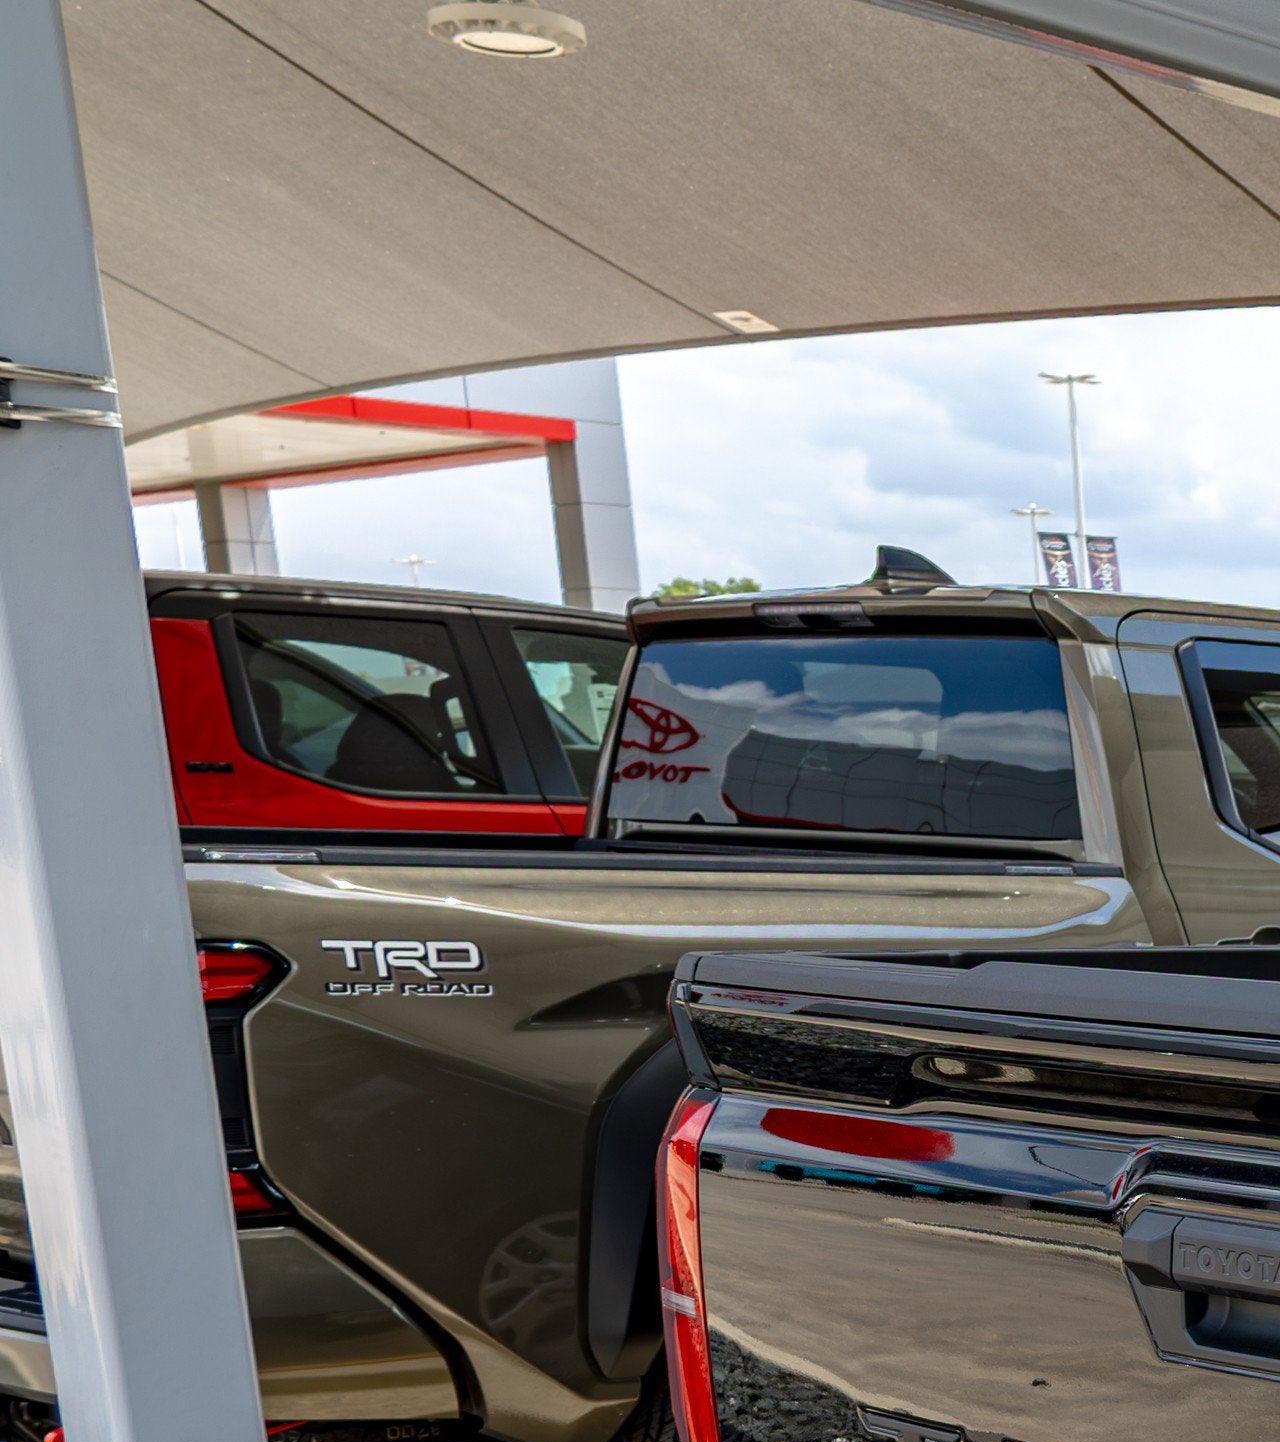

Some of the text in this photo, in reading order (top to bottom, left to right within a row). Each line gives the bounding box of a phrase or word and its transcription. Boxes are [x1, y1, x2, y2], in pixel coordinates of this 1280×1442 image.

[321, 939, 485, 980] TRD
[325, 982, 494, 997] OFF ROAD
